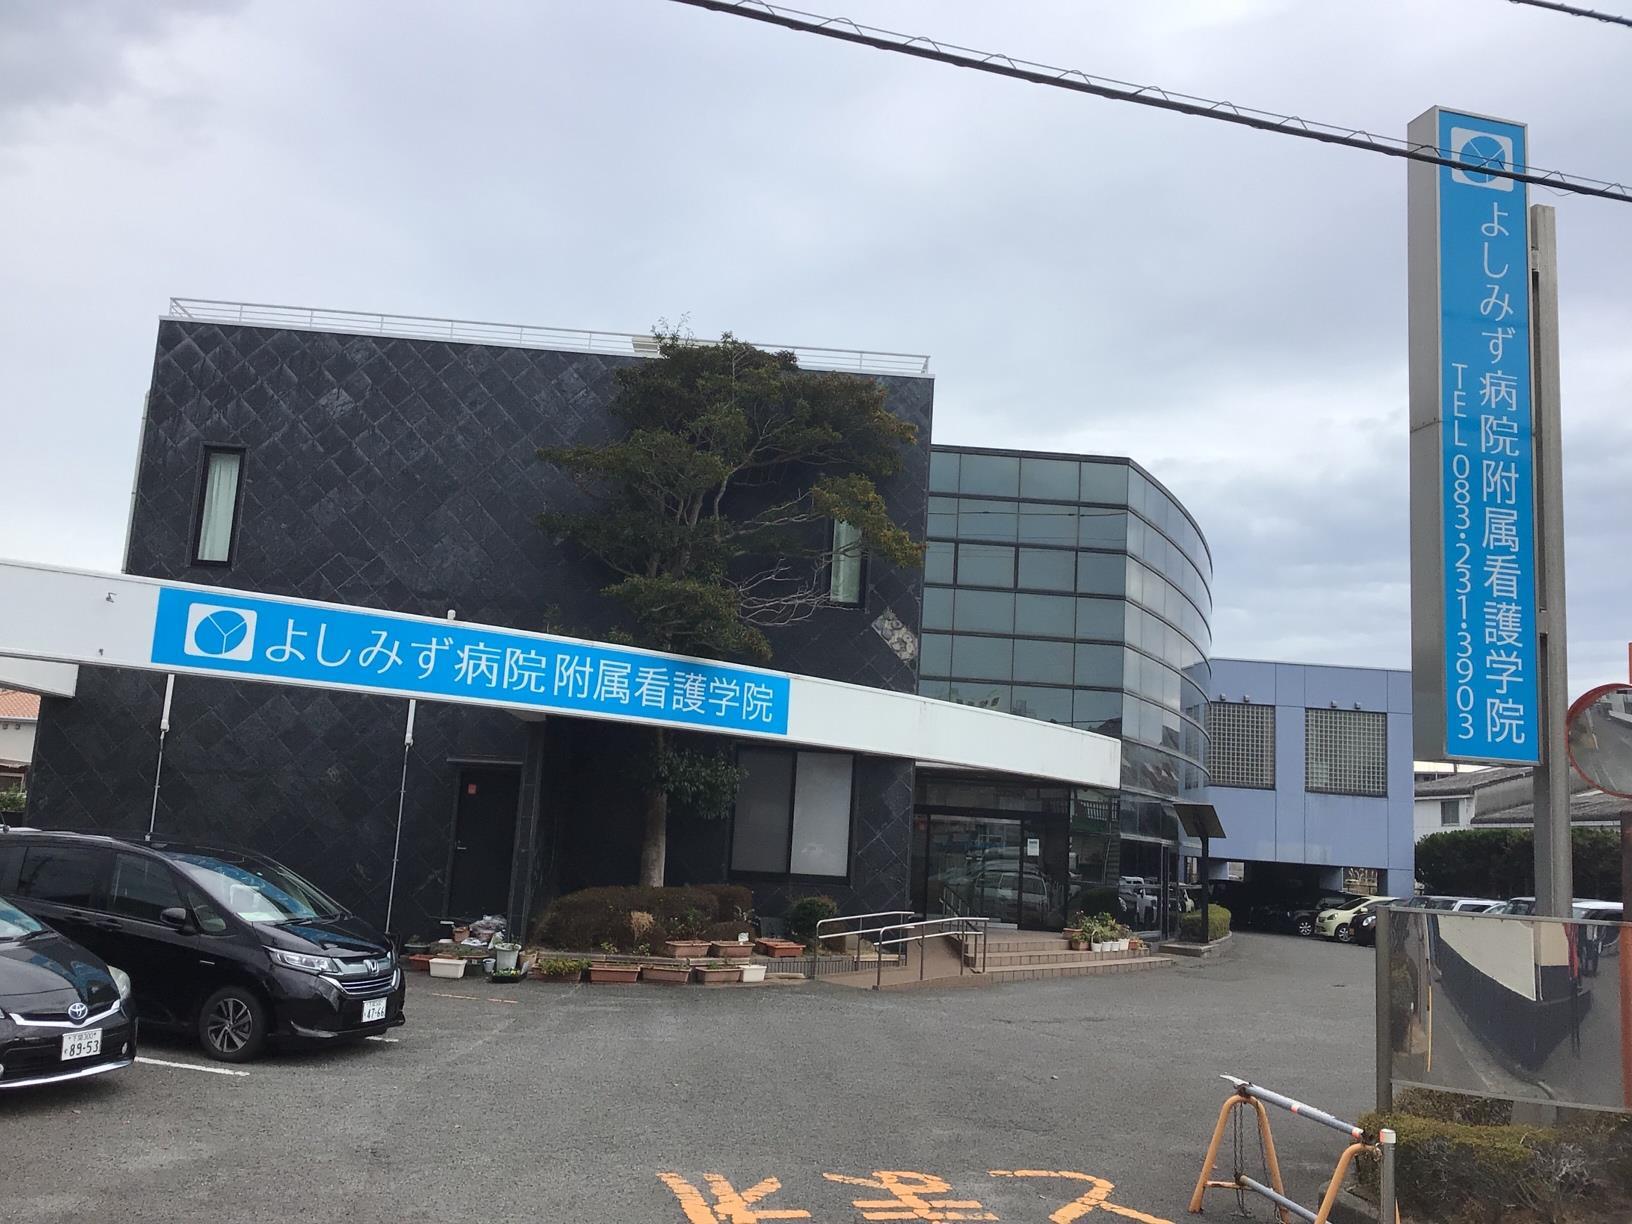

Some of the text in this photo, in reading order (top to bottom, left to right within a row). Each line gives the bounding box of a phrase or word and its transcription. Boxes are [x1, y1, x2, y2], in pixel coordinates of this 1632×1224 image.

[1480, 202, 1526, 744] よしみず病院附属看護学院
[69, 1040, 99, 1057] 89-53
